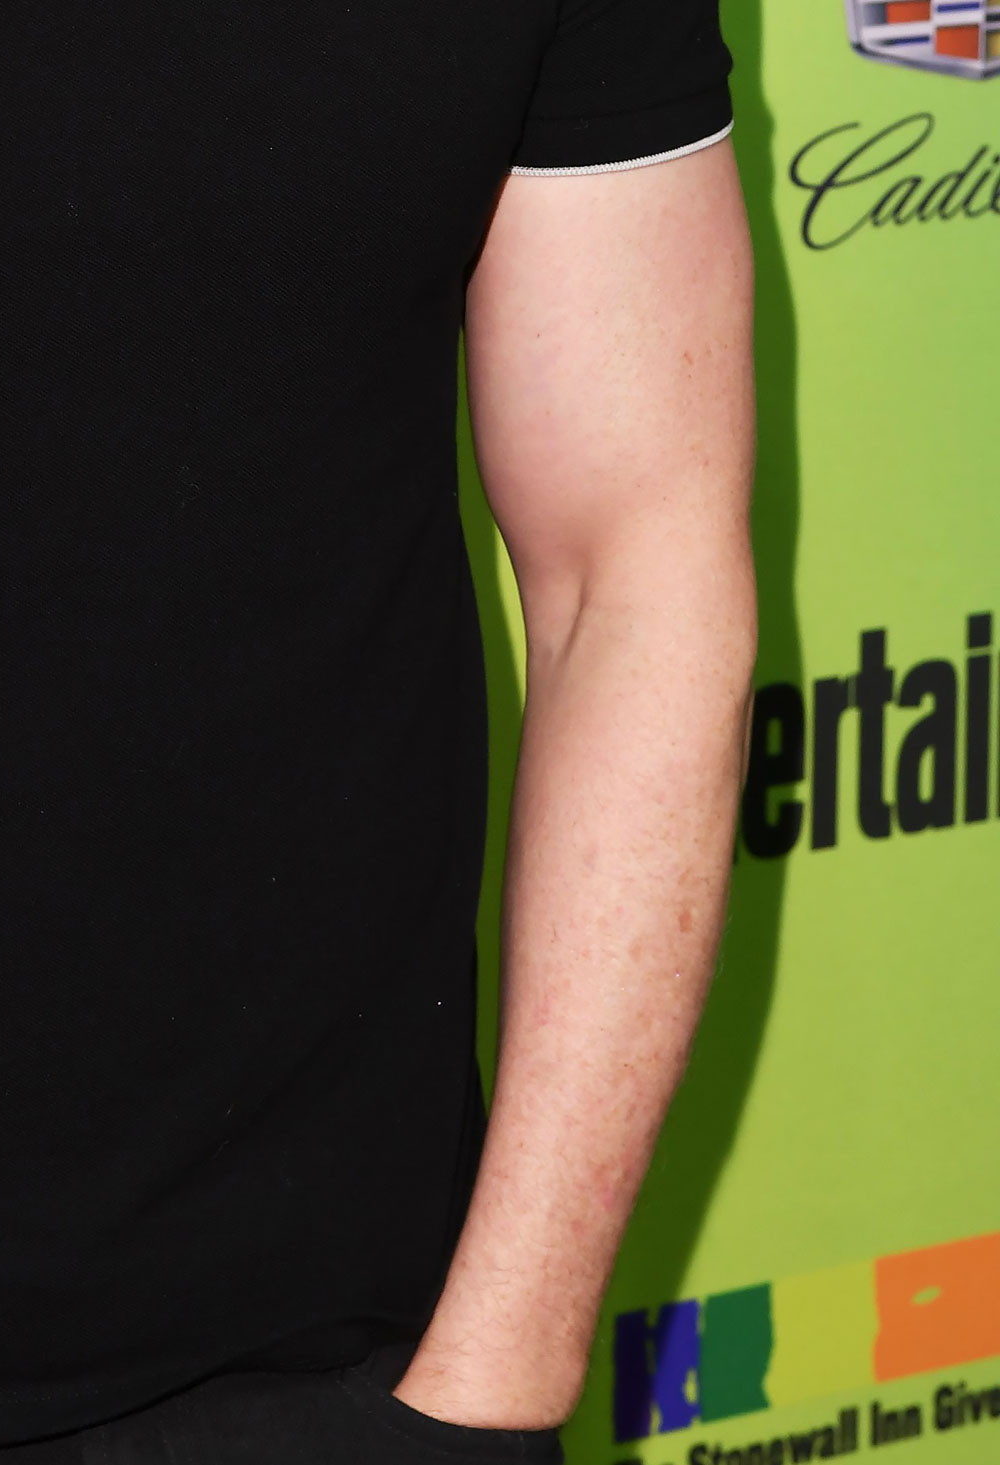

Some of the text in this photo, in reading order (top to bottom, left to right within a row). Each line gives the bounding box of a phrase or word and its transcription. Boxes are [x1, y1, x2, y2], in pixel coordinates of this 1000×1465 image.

[789, 112, 1000, 250] Cadi
[736, 609, 1000, 861] ertai
[870, 1400, 922, 1447] Inn
